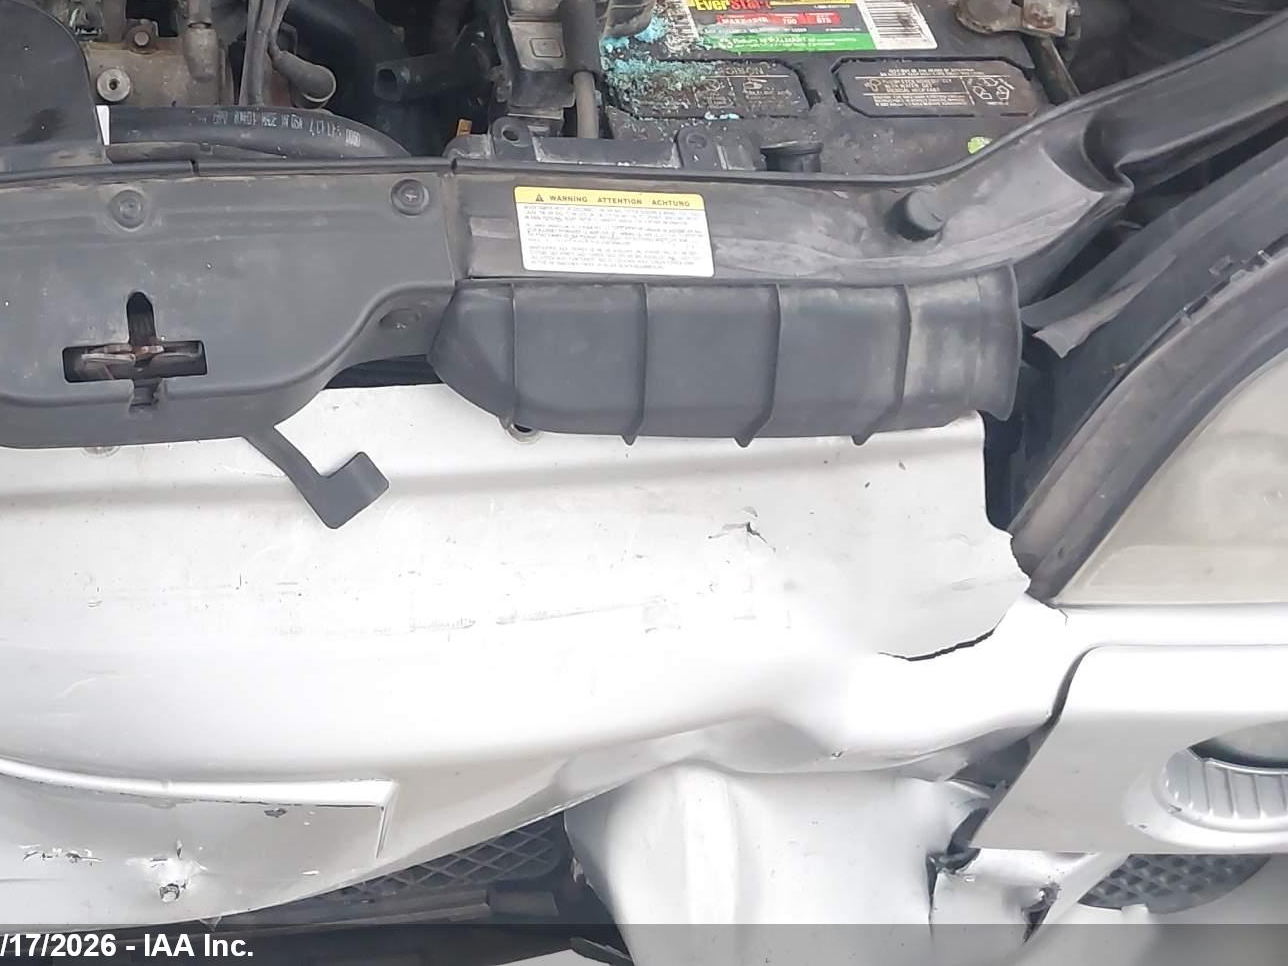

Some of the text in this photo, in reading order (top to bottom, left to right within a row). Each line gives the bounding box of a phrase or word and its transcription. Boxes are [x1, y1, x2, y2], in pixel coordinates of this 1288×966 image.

[548, 194, 691, 207] WARNING ATTENTION ACHTUNG
